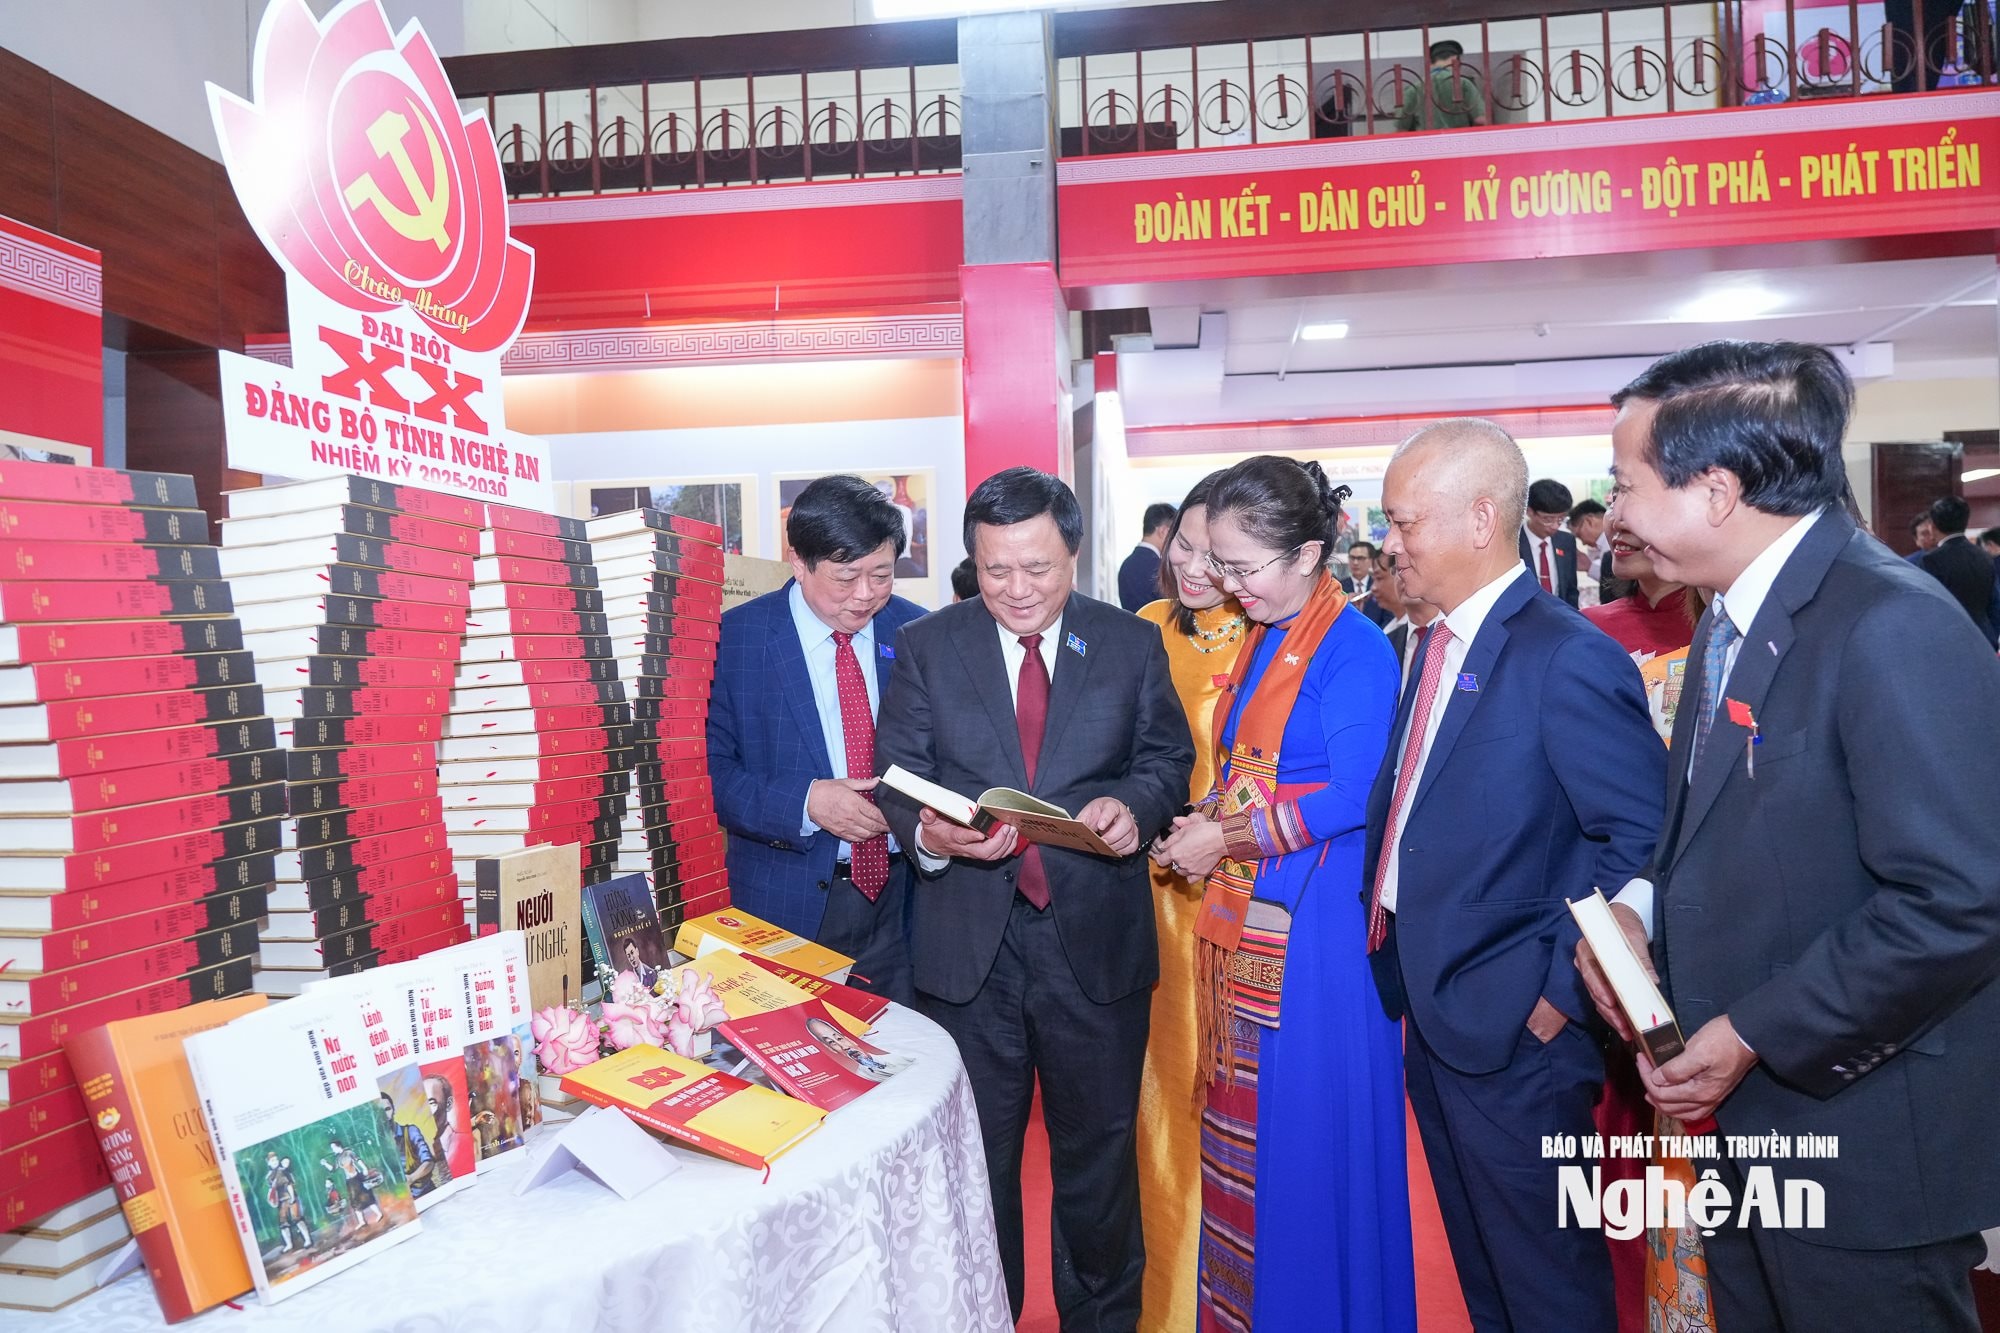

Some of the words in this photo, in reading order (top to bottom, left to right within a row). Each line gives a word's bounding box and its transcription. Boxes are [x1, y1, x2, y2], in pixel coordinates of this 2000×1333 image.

[1135, 191, 1211, 243] ĐOÀN
[1220, 182, 1271, 238] KẾT
[1300, 182, 1359, 233] DÂN
[1367, 170, 1426, 229] CHỦ
[1463, 164, 1500, 222] KỶ
[1510, 168, 1612, 219] CƯƠNG
[1641, 156, 1698, 218] ĐỘT
[1708, 150, 1771, 206] PHÁ
[1800, 143, 1879, 198] PHÁT
[1888, 127, 1980, 192] TRIỂN
[343, 259, 402, 302] Chào
[408, 287, 471, 335] Mừng
[361, 314, 405, 349] ĐẠI
[411, 334, 451, 364] HỘI
[318, 325, 489, 436] XX
[245, 381, 331, 433] ĐẢNG
[339, 406, 377, 450] BỘ
[385, 416, 445, 461] TỈNH
[450, 436, 509, 481] NGHỆ
[514, 452, 540, 482] AN
[311, 440, 380, 476] NHIỆM
[388, 454, 413, 481] KỲ
[419, 464, 508, 498] 2025-2030
[517, 889, 553, 931] NGƯỜI
[603, 888, 632, 911] HỪNG
[609, 907, 637, 930] ĐÔNG
[525, 932, 535, 967] Ứ
[536, 921, 568, 963] NGHỆ
[362, 1009, 384, 1028] Lênh
[369, 1028, 390, 1047] đênh
[336, 1075, 357, 1093] non
